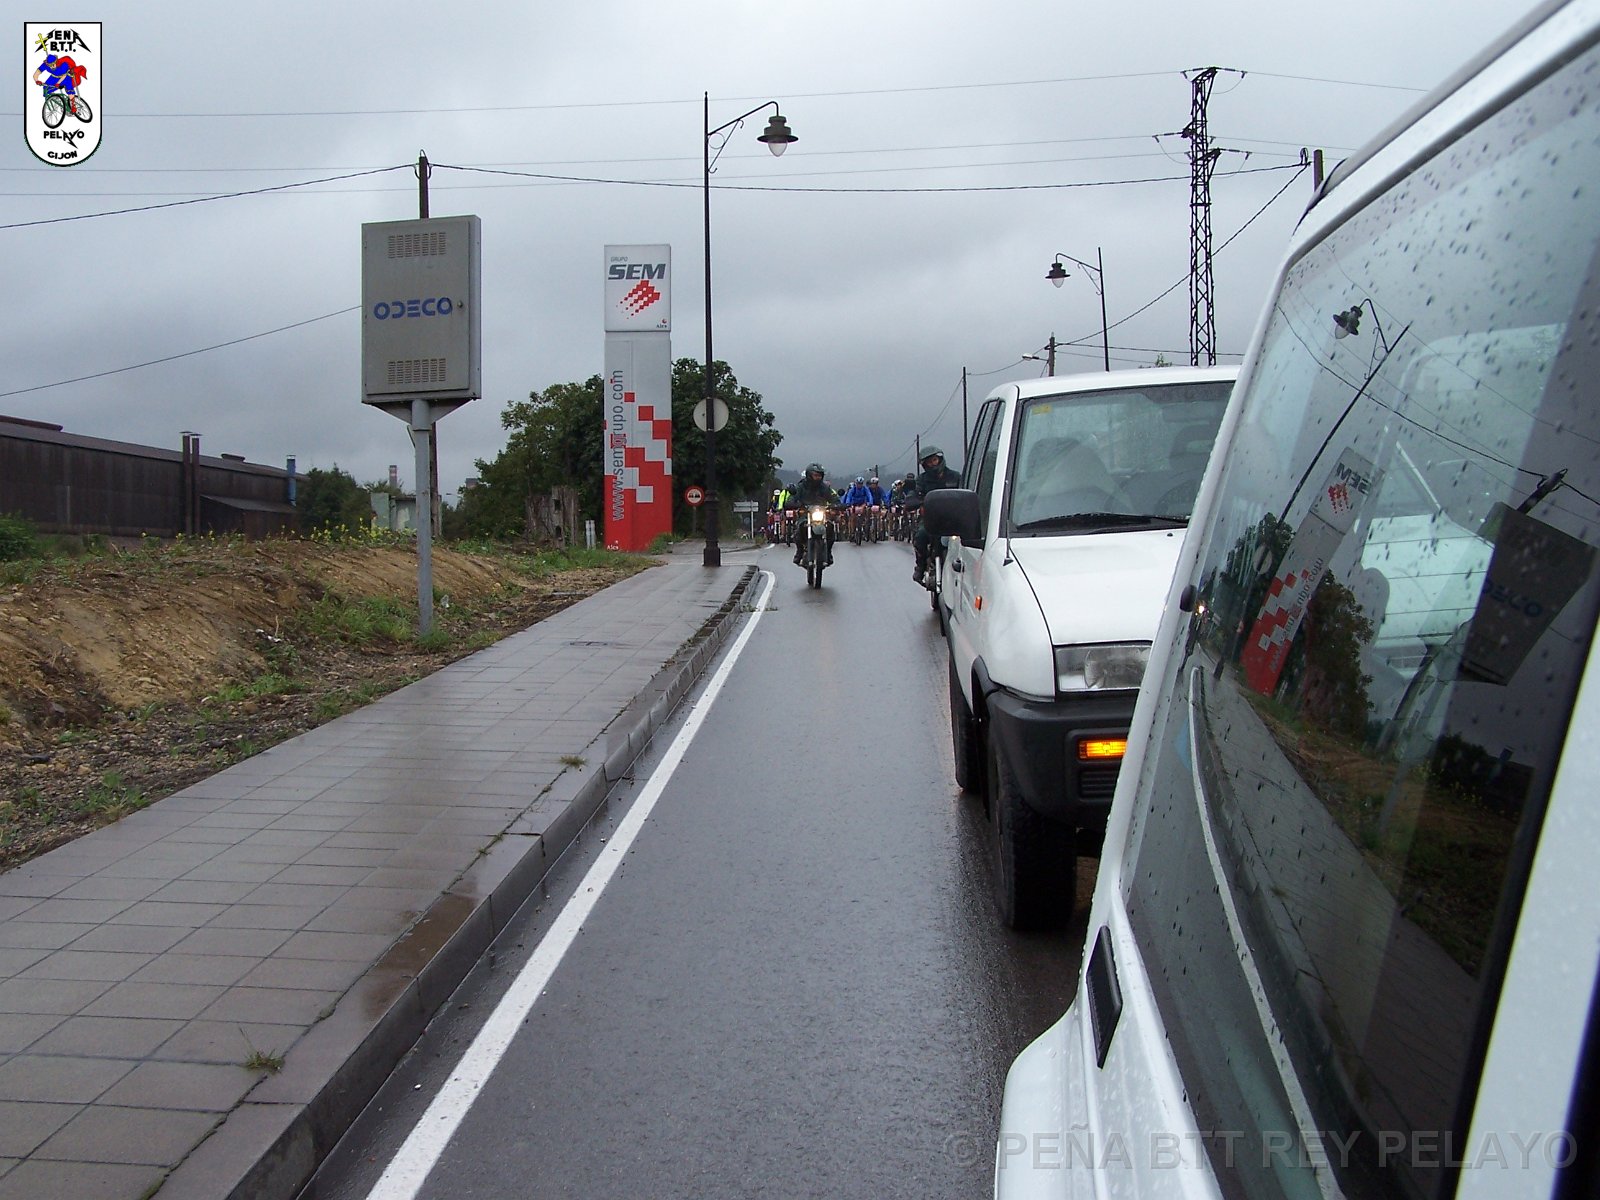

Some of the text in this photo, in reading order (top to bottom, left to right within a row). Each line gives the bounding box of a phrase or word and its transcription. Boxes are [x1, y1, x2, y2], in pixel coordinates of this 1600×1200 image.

[608, 263, 666, 280] SEM
[373, 296, 454, 321] ODECO
[612, 370, 627, 522] www.semgrupo.com
